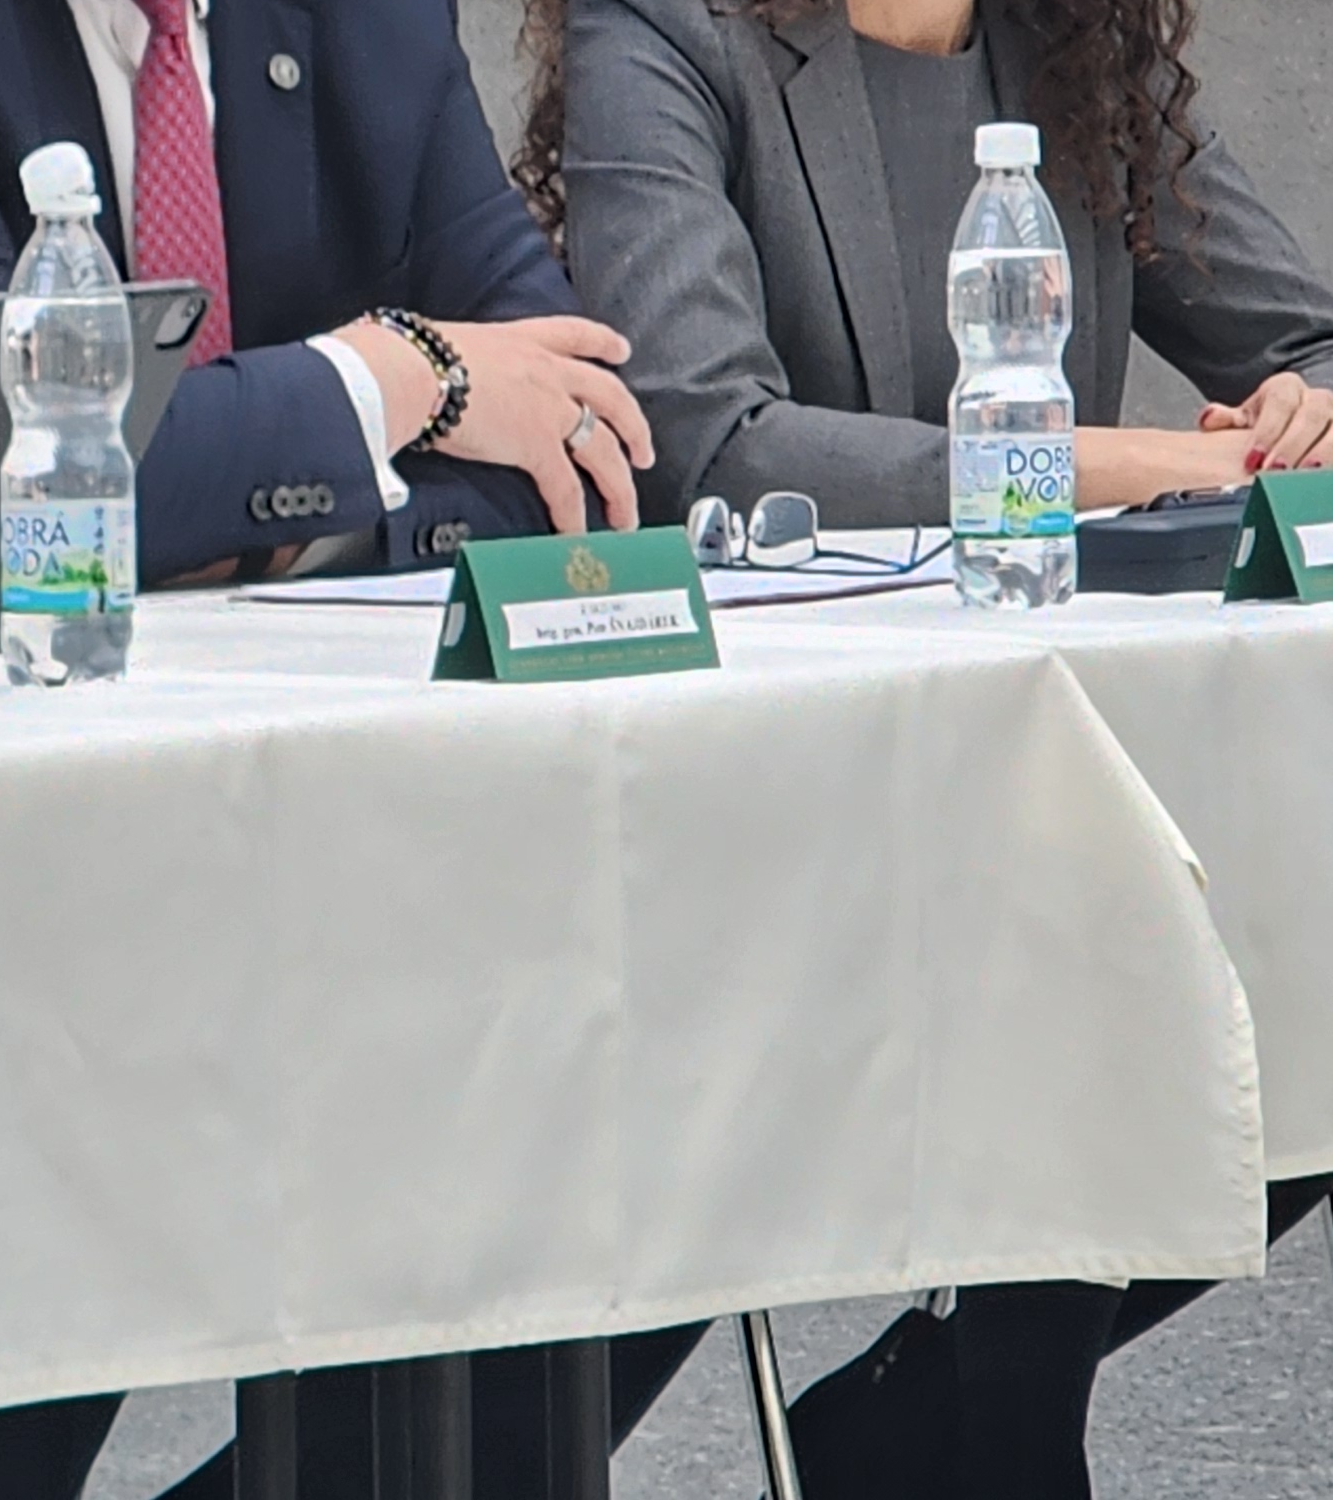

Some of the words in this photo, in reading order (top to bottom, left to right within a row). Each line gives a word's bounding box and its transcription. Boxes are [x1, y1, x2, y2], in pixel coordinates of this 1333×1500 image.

[1015, 475, 1073, 503] VOD
[3, 510, 71, 546] OBRÁ
[5, 547, 63, 579] ODA
